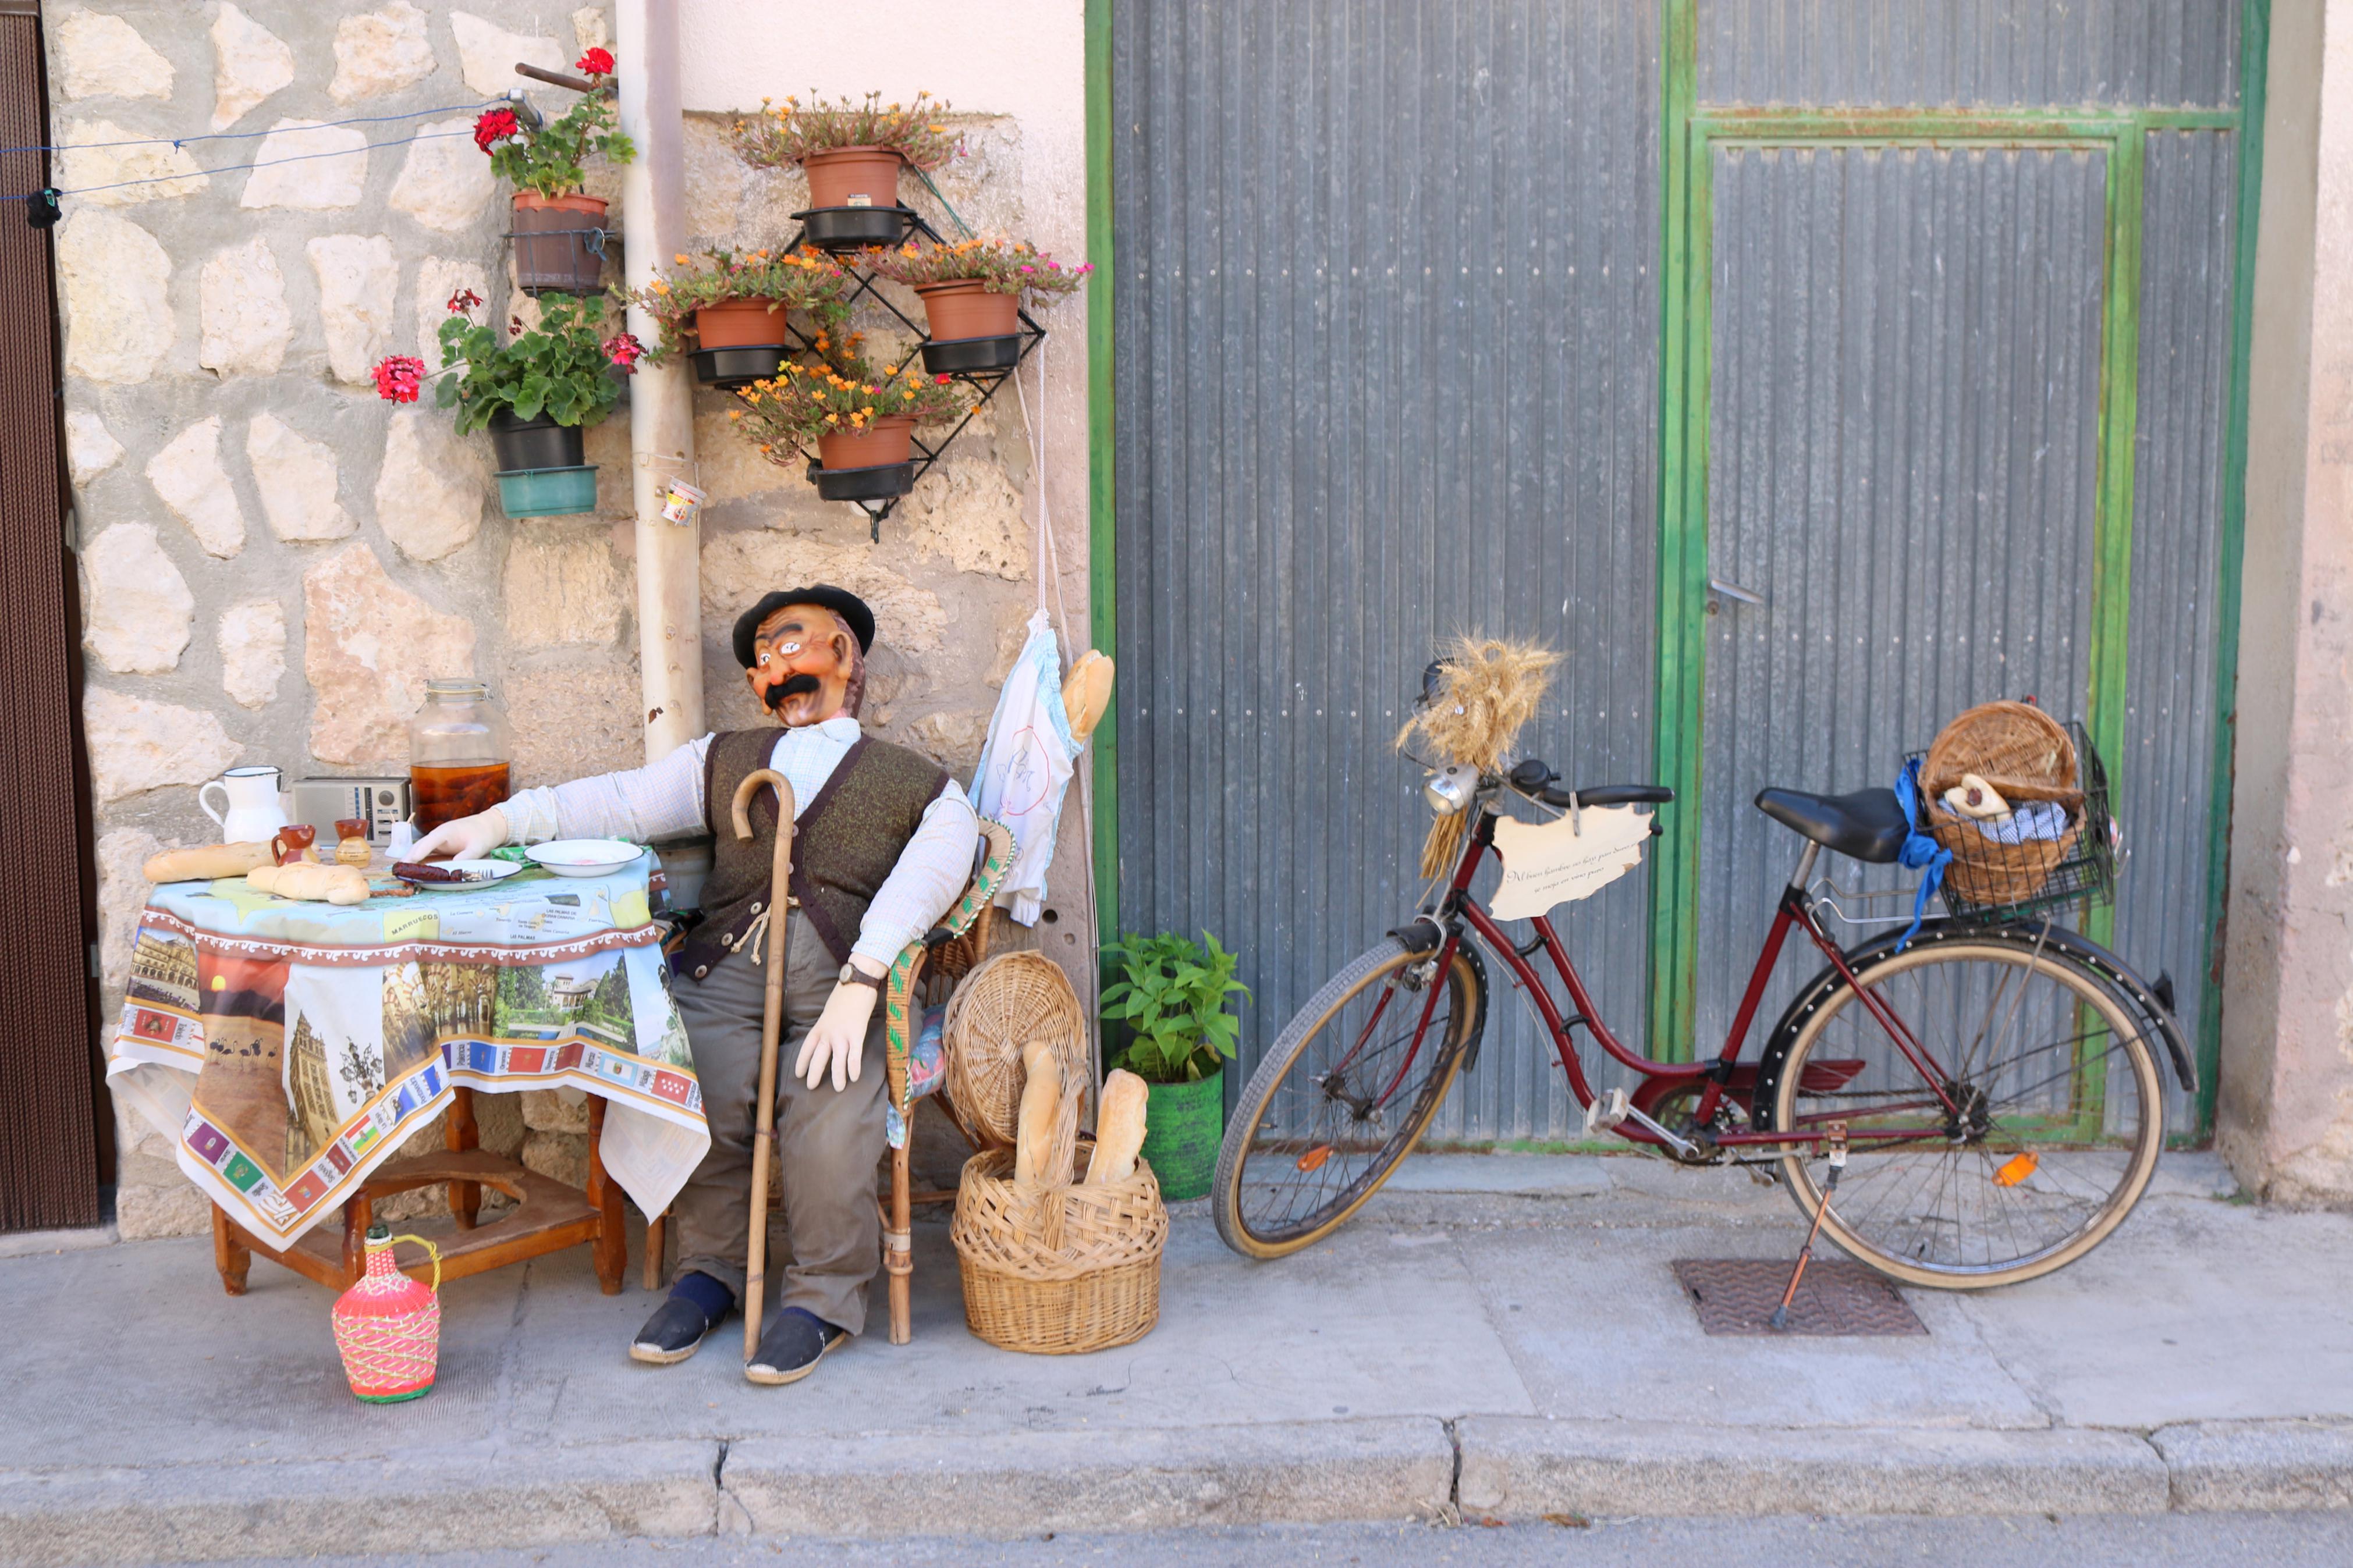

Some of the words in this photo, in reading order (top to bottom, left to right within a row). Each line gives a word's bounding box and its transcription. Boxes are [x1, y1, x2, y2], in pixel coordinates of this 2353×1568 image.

[392, 914, 438, 936] MARRUECOS
[174, 1023, 187, 1040] Toledo
[456, 1044, 465, 1066] Palencia
[585, 1052, 596, 1069] Murcia
